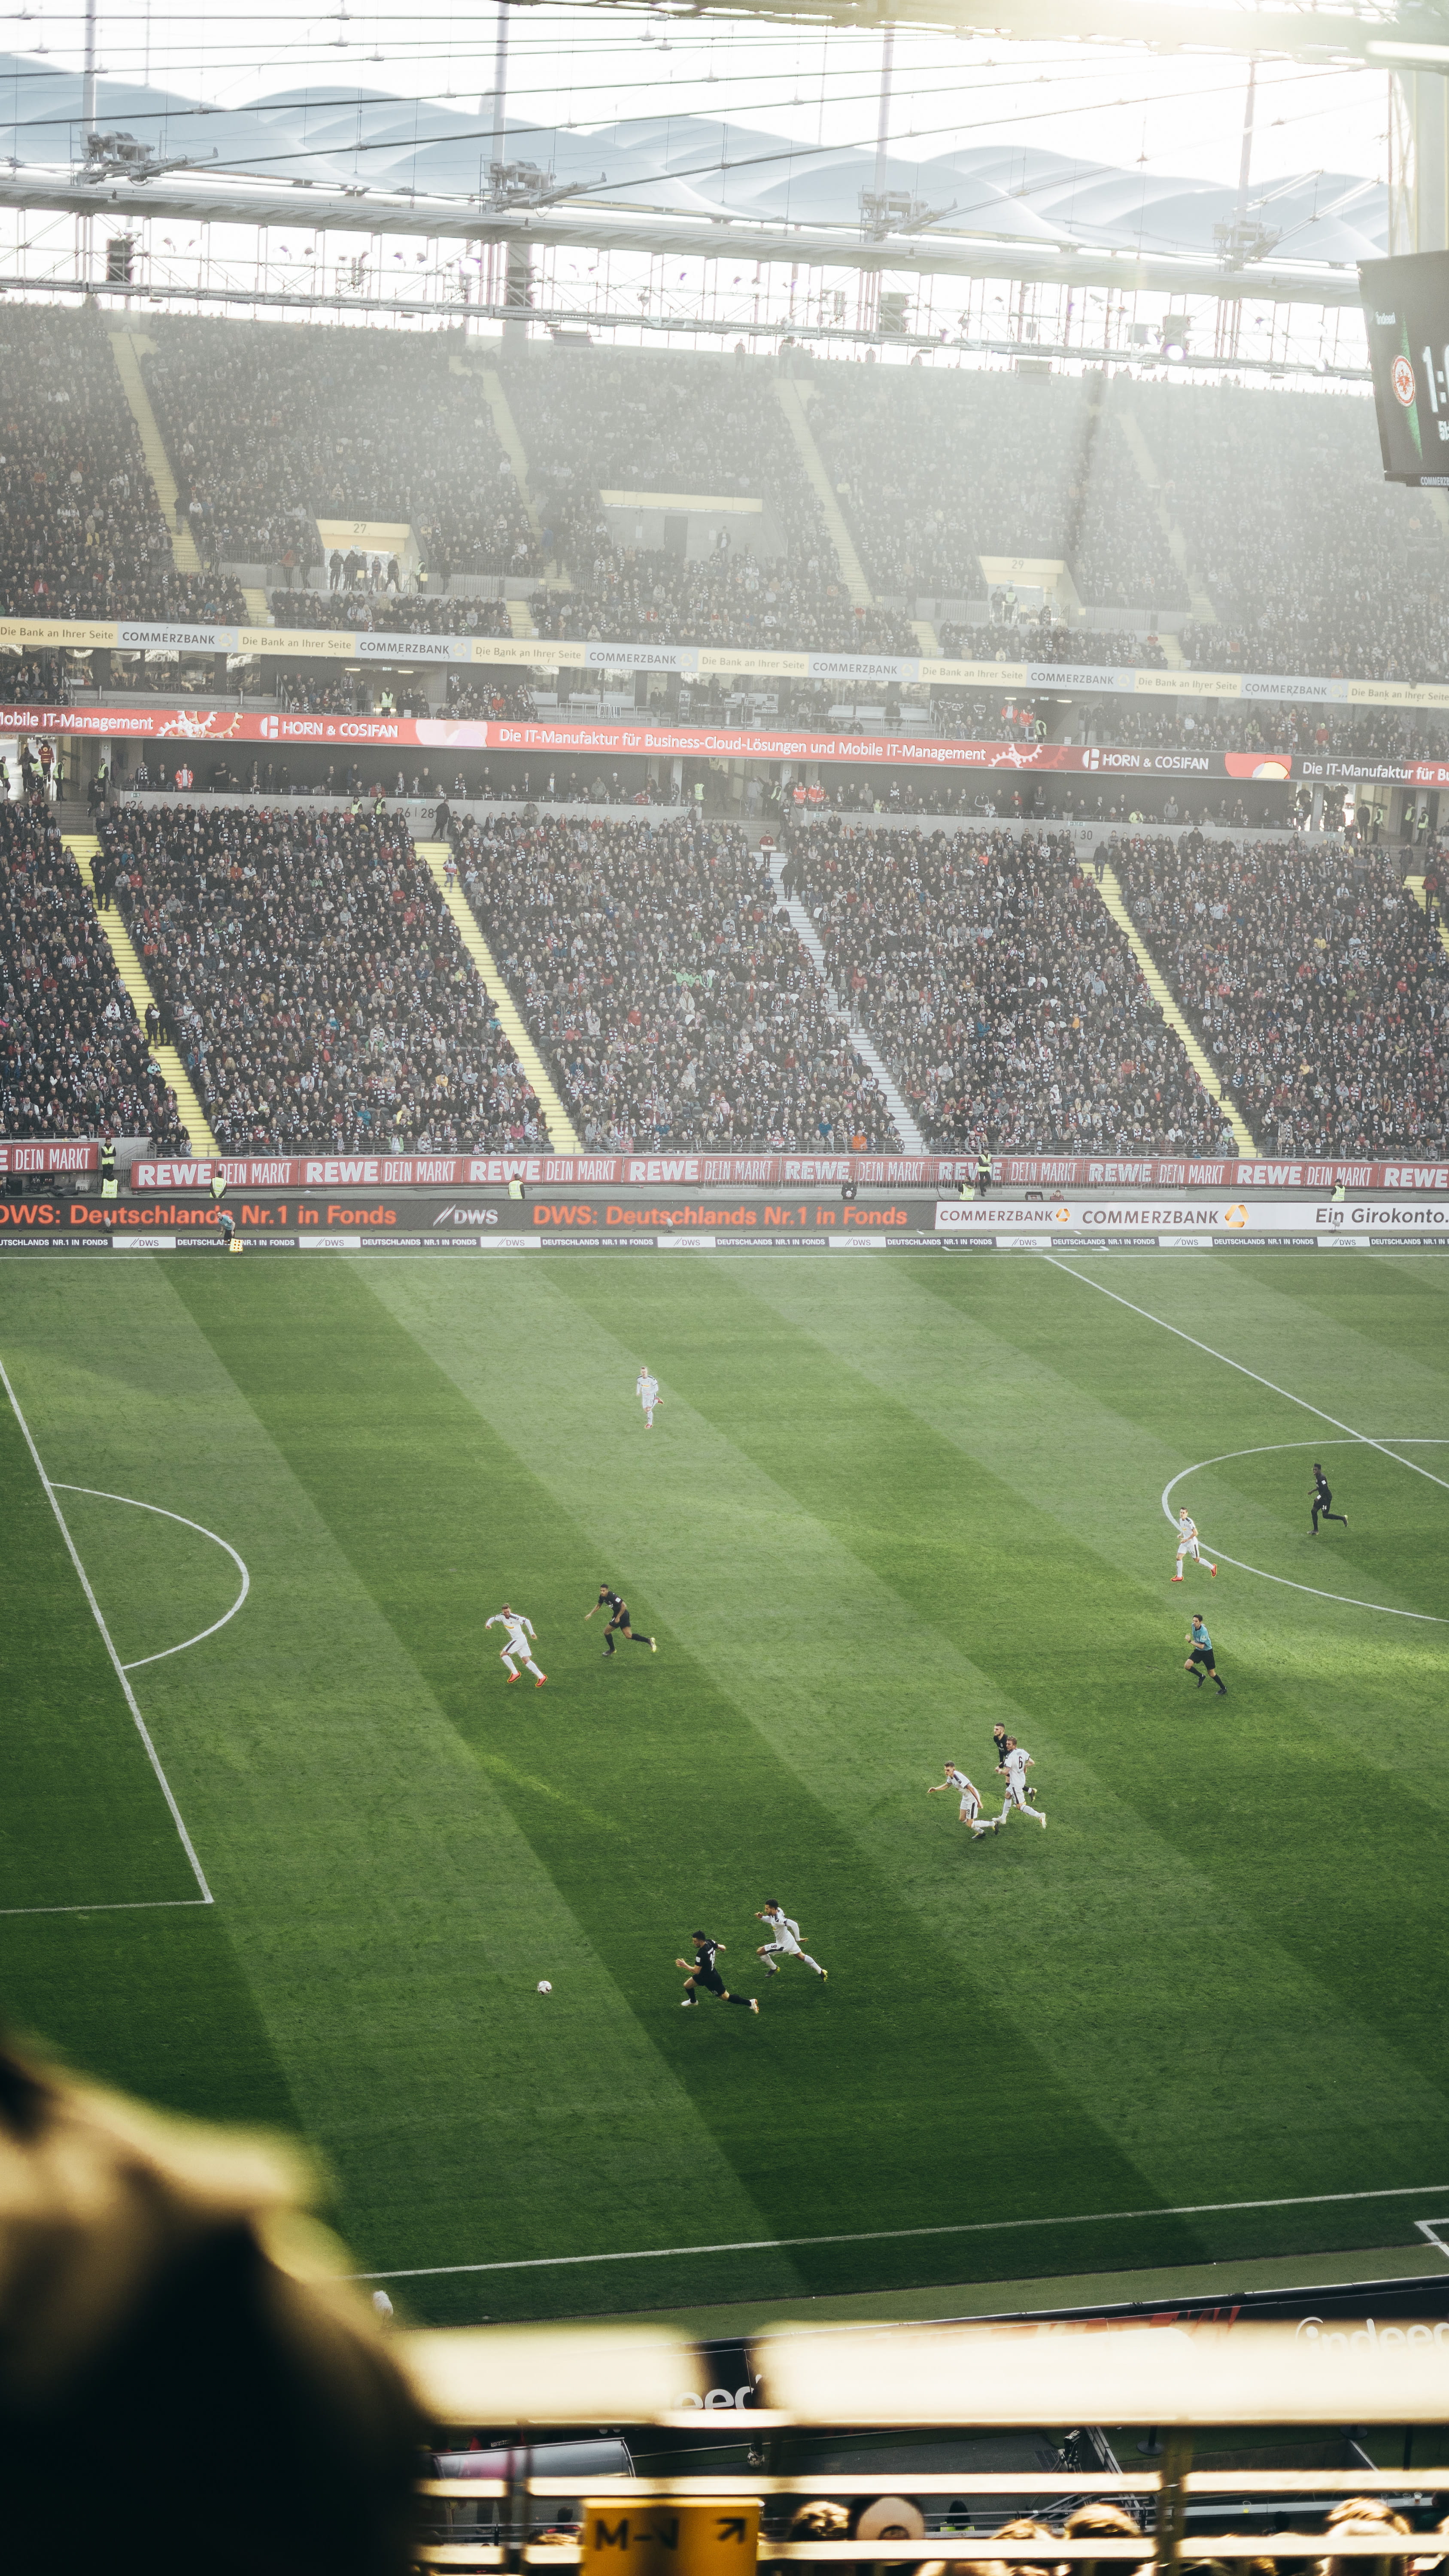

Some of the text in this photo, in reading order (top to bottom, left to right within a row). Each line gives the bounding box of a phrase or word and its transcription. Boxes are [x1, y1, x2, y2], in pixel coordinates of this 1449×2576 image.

[1376, 311, 1395, 325] indeed
[353, 523, 366, 534] 27
[1012, 559, 1024, 569] 29
[0, 627, 16, 635] Die
[20, 628, 44, 637] Bank
[63, 630, 86, 638] Ihrer
[90, 631, 113, 639] Seite
[123, 632, 215, 644] COMMERZBANK
[243, 637, 258, 645] Die
[262, 638, 284, 646] Bank
[302, 639, 325, 648] Ihrer
[328, 640, 351, 649] Seite
[360, 642, 449, 654] COMMERZBANK
[476, 647, 491, 655] Die
[494, 648, 516, 656] Bank
[534, 649, 556, 658] Ihrer
[559, 650, 581, 659] Seite
[590, 652, 676, 664] COMMERZBANK
[702, 656, 717, 665] Die
[720, 658, 741, 666] Bank
[759, 659, 780, 668] Ihrer
[783, 661, 804, 669] Seite
[813, 662, 897, 674] COMMERZBANK
[923, 667, 936, 675] Die
[940, 668, 961, 676] Bank
[978, 669, 998, 678] Ihrer
[1002, 671, 1023, 679] Seite
[1031, 672, 1114, 684] COMMERZBANK
[1139, 677, 1152, 686] Die
[1156, 679, 1176, 687] Bank
[1193, 680, 1213, 689] Ihrer
[1216, 682, 1237, 690] Seite
[1245, 683, 1327, 695] COMMERZBANK
[1352, 688, 1365, 696] Die
[1368, 690, 1388, 698] Bank
[1428, 692, 1449, 701] Seite
[44, 713, 153, 731] IT-Management
[283, 721, 398, 738] HORN & COSIFAN
[500, 729, 985, 760] Die IT-Manufaktur für Business-Cloud-Lösungen und Mobile IT-Management
[1103, 754, 1208, 769] HORN & COSIFAN
[1303, 762, 1322, 775] Die
[1326, 763, 1414, 779] IT-Manufaktur
[1416, 767, 1435, 781] für
[421, 808, 434, 818] 28
[1080, 830, 1093, 840] 30
[15, 1149, 43, 1170] DEIN
[50, 1148, 90, 1169] MARKT
[138, 1163, 291, 1185] REWE DEIN MARKT
[307, 1161, 456, 1182] REWE DEIN MARKT
[471, 1160, 616, 1181] REWE DEIN MARKT
[630, 1160, 772, 1181] REWE DEIN MARKT
[785, 1161, 850, 1180] REWE
[859, 1161, 882, 1181] DEIN
[888, 1162, 924, 1181] MARKT
[1011, 1162, 1036, 1181] DEIN
[1041, 1162, 1077, 1182] MARKT
[1089, 1163, 1224, 1184] REWE DEIN MARKT
[1237, 1166, 1372, 1186] REWE DEIN MARKT
[1384, 1168, 1448, 1188] REWE
[70, 1205, 233, 1224] Deutschlands
[298, 1205, 319, 1224] in
[327, 1205, 396, 1225] Fonds
[454, 1209, 498, 1224] DWS
[533, 1205, 598, 1225] DWS:
[606, 1206, 756, 1225] Deutschlands
[817, 1206, 835, 1225] in
[844, 1206, 907, 1225] Fonds
[940, 1210, 1053, 1221] COMMERZBANK
[1082, 1210, 1218, 1224] COMMERZBANK
[1316, 1208, 1449, 1223] Ein Girokonto.
[1018, 1756, 1023, 1769] 6
